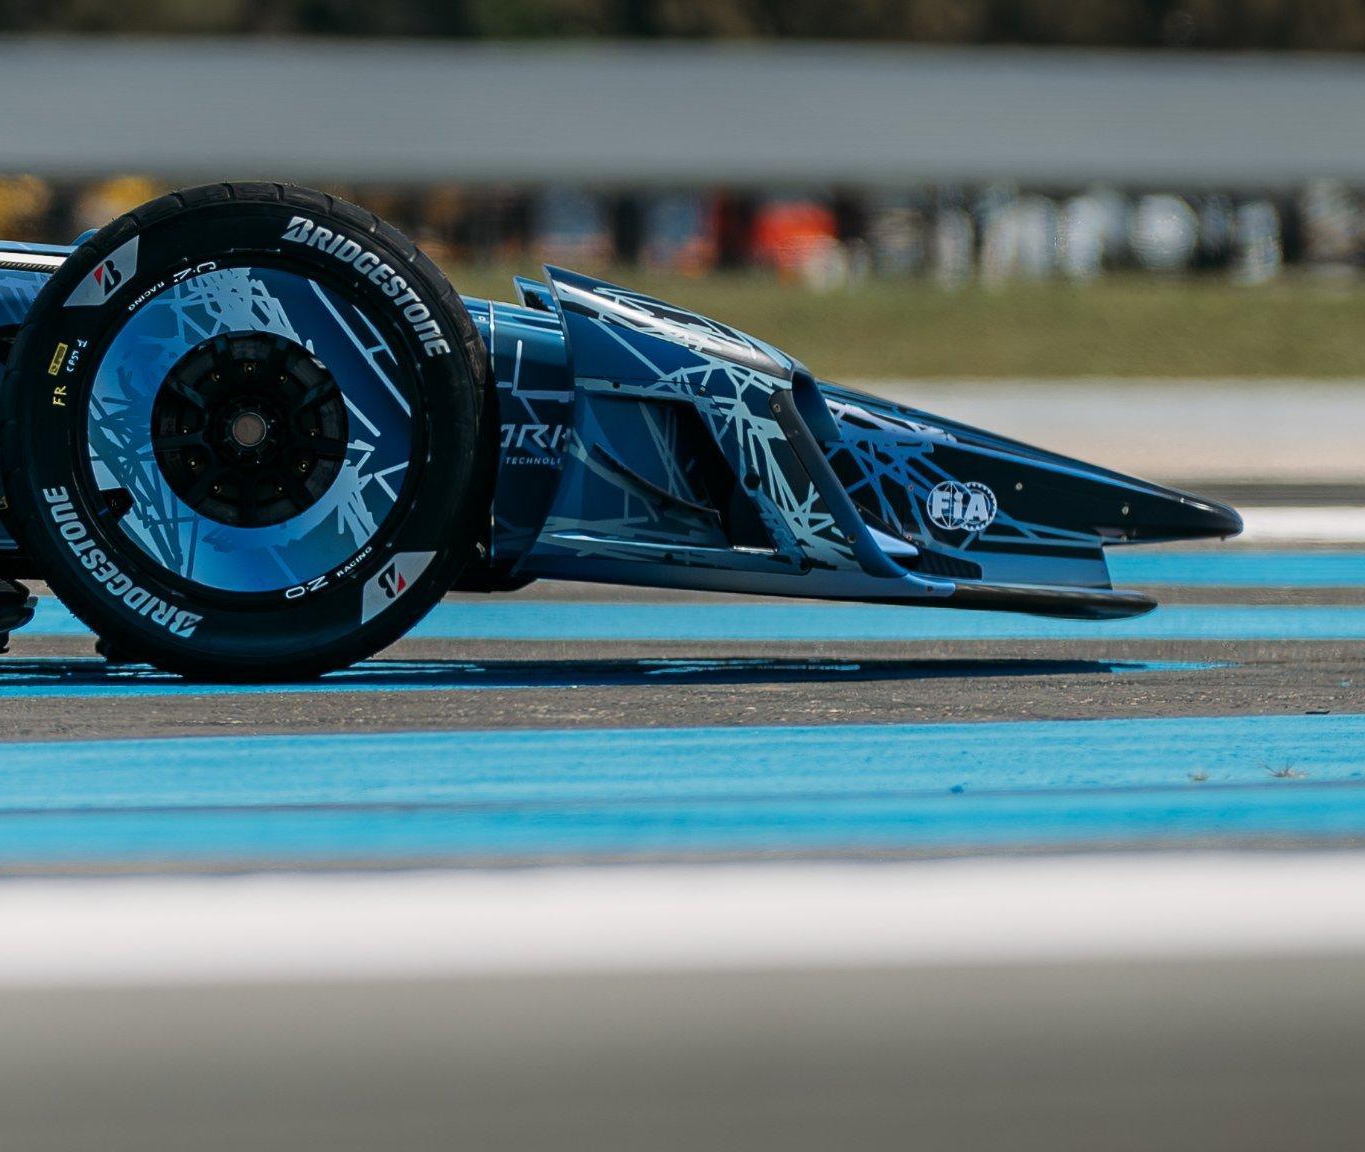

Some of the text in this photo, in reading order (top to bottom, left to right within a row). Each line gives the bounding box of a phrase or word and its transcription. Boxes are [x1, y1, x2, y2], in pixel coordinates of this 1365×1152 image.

[127, 280, 166, 311] RACING
[281, 215, 451, 358] BRIDGESTONE
[52, 385, 68, 406] FR
[43, 485, 204, 638] BRIDGESTONE
[335, 545, 373, 578] RACING
